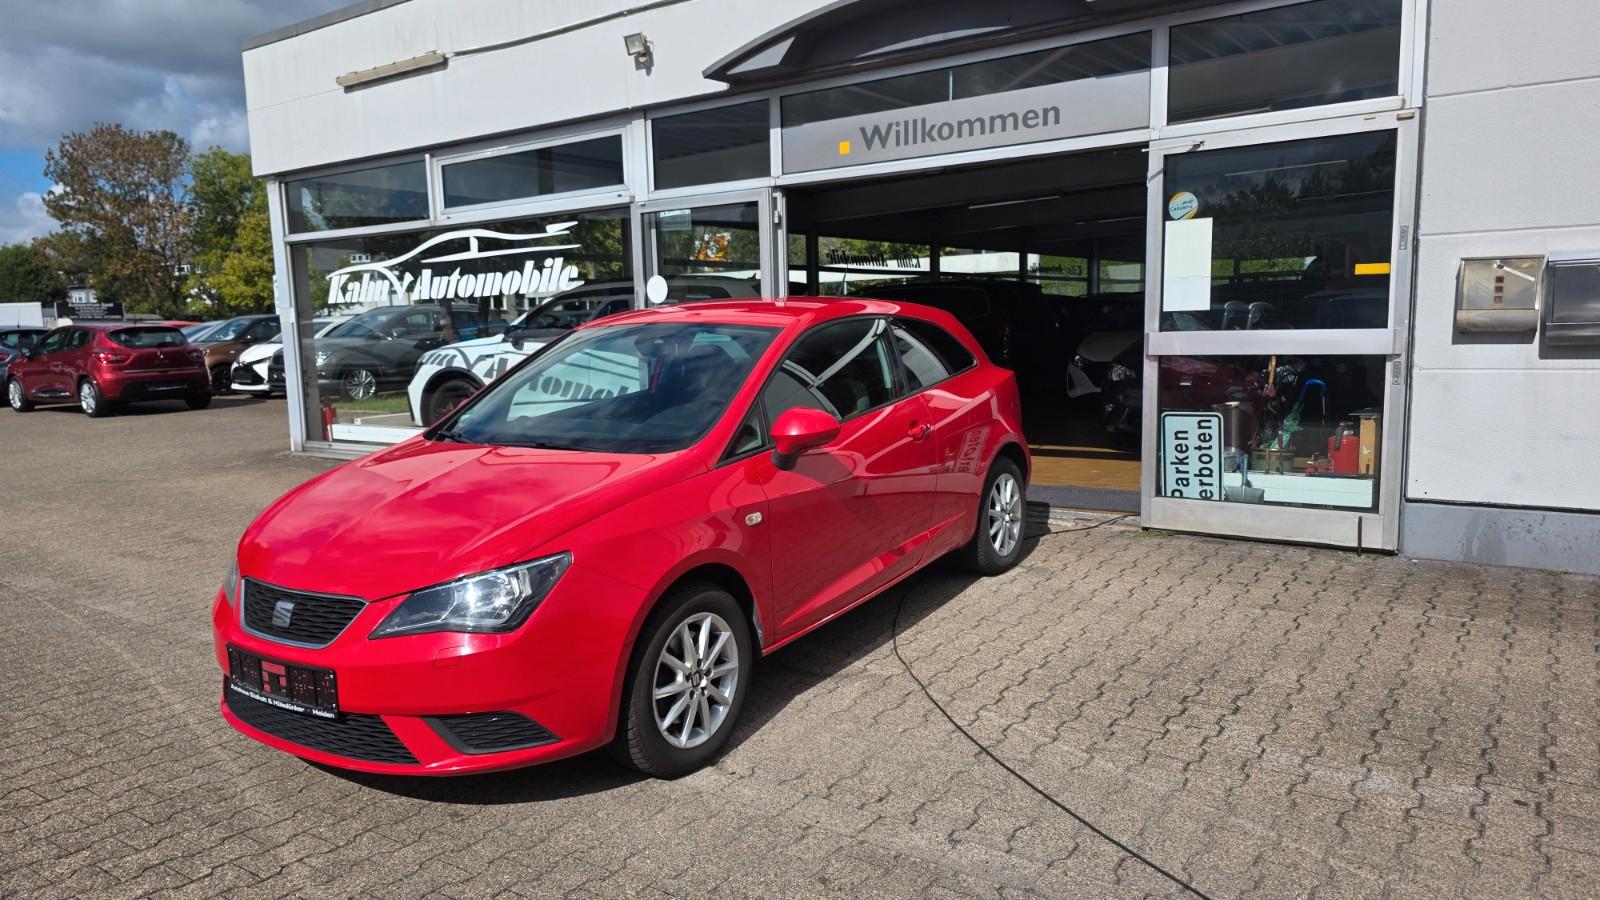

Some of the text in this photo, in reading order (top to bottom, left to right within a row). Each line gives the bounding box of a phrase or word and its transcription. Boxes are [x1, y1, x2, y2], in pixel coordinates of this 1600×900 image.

[860, 105, 1061, 151] Willkommen
[412, 257, 585, 301] Automobile
[1169, 430, 1190, 498] Parken
